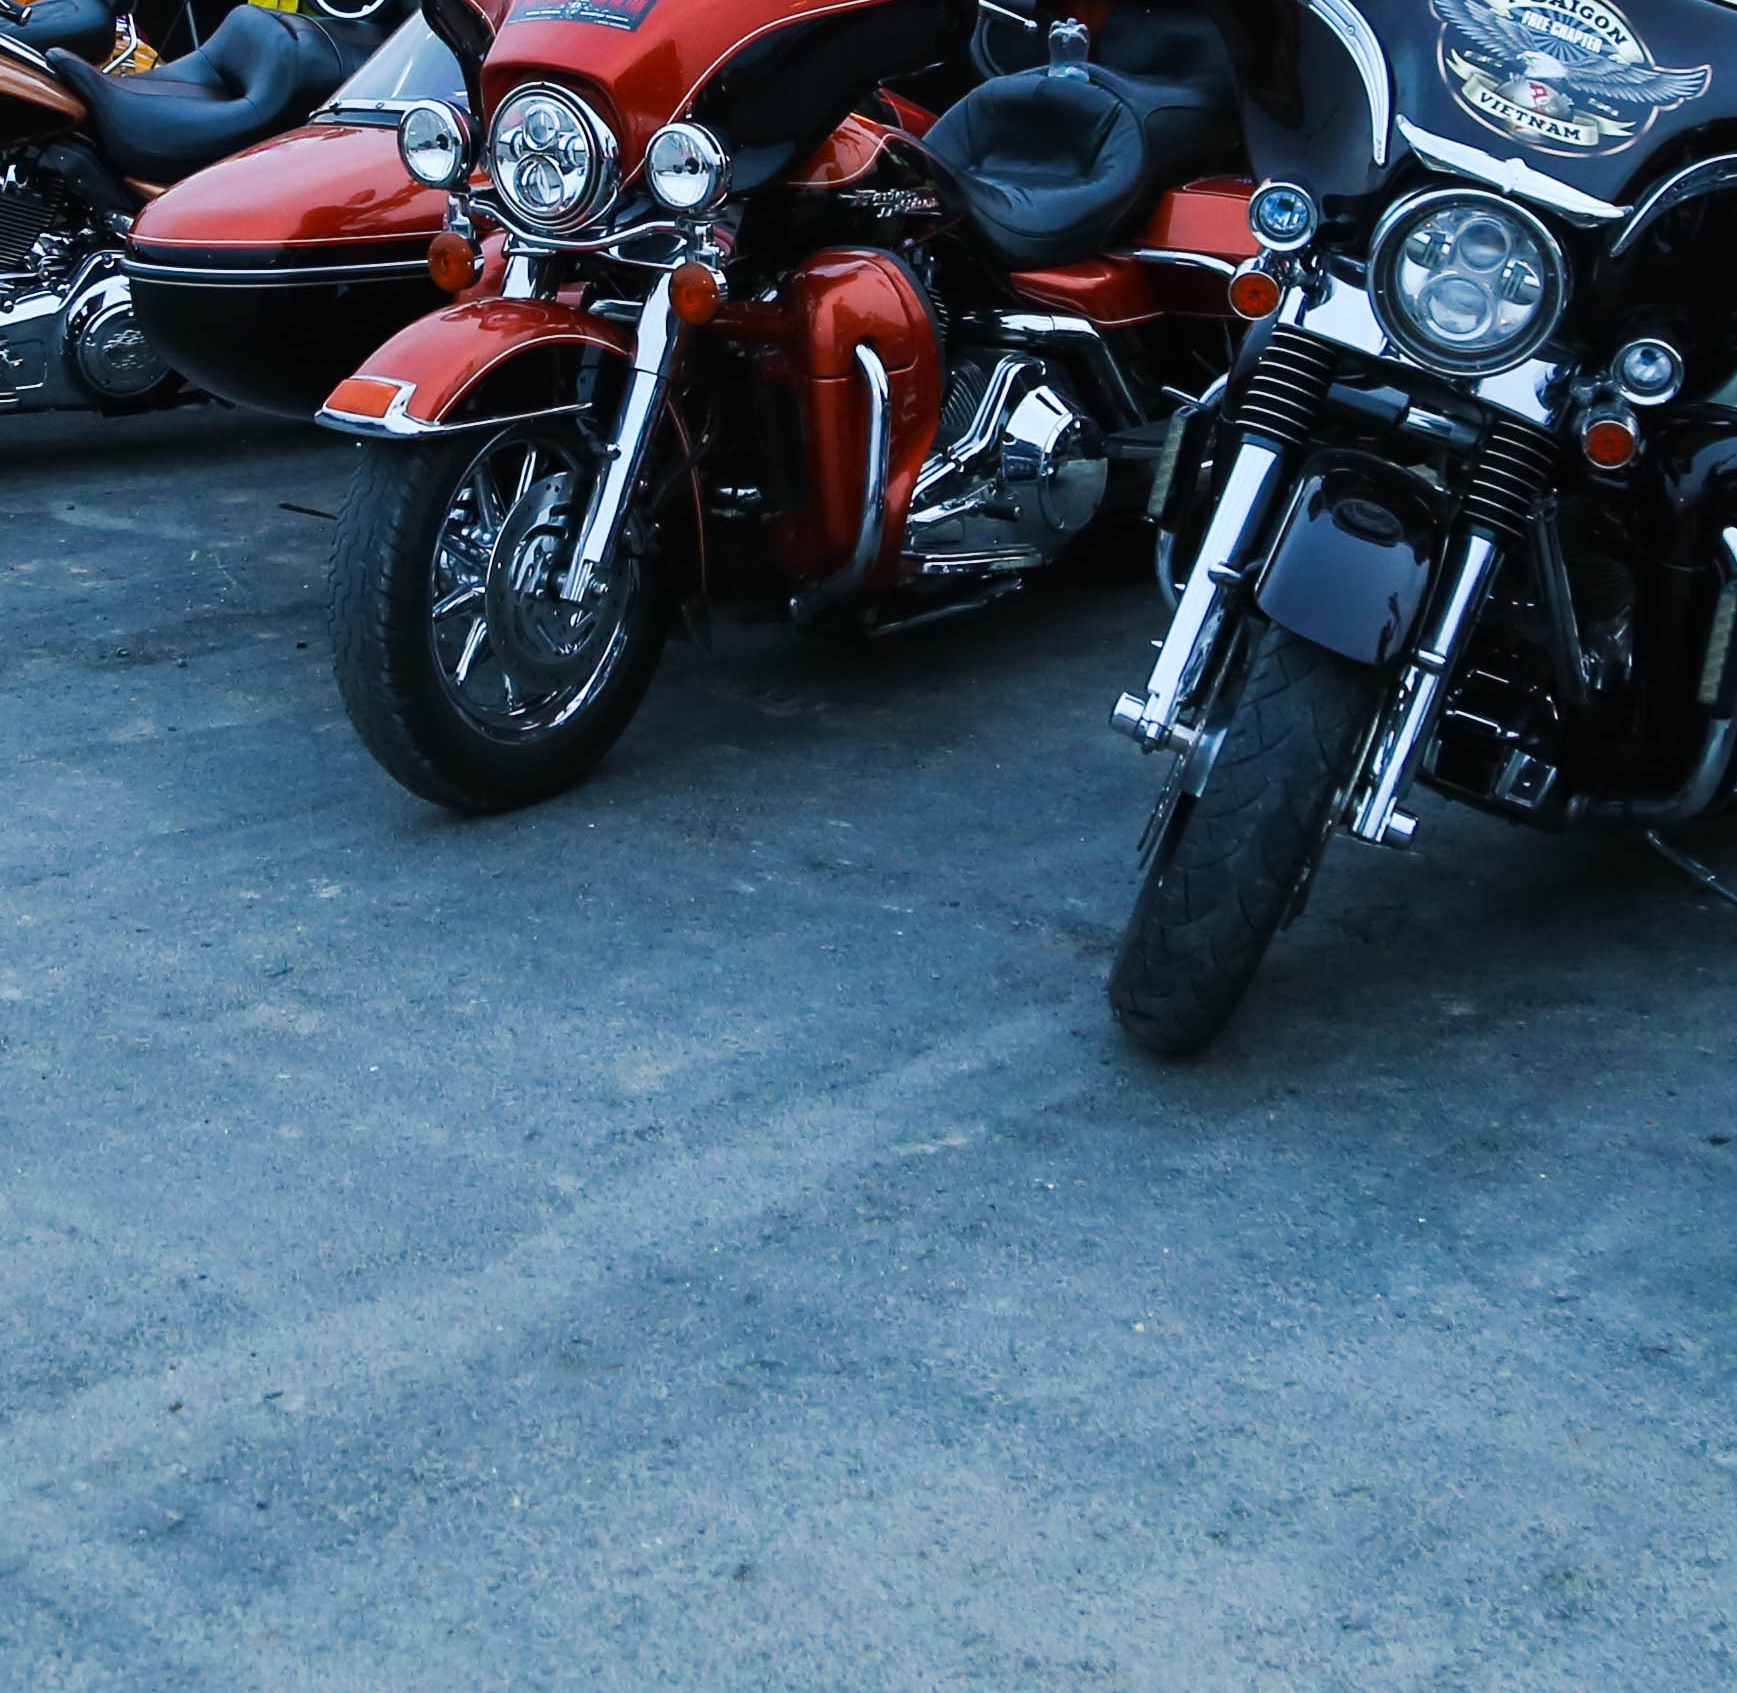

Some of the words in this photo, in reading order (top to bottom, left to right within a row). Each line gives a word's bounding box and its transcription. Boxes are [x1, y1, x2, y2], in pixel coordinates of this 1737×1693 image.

[1520, 9, 1553, 34] FREE
[1550, 20, 1604, 55] CHAPTER
[1479, 91, 1582, 141] VIETNAM
